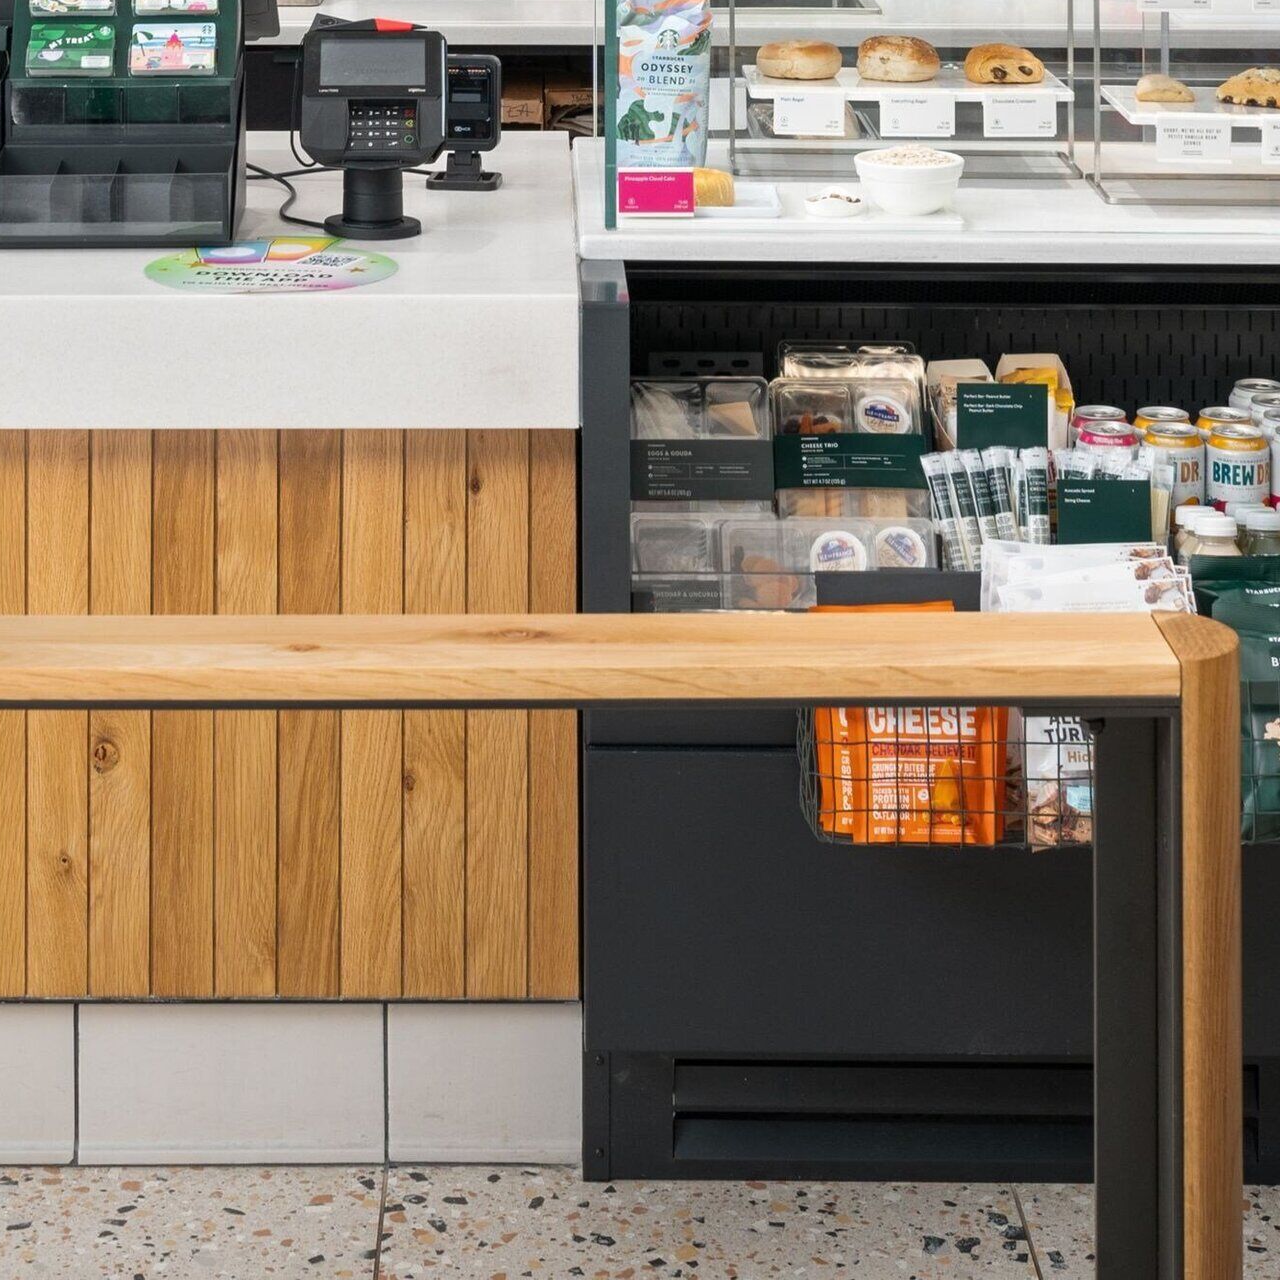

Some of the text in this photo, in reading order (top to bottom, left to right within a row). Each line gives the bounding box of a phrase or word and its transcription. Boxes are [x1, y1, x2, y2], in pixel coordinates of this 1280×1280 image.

[49, 32, 94, 50] MY TREAT
[641, 63, 694, 74] ODYSSEY
[649, 75, 685, 86] BLEND
[1213, 462, 1254, 486] BREW
[868, 707, 977, 736] CHEESE
